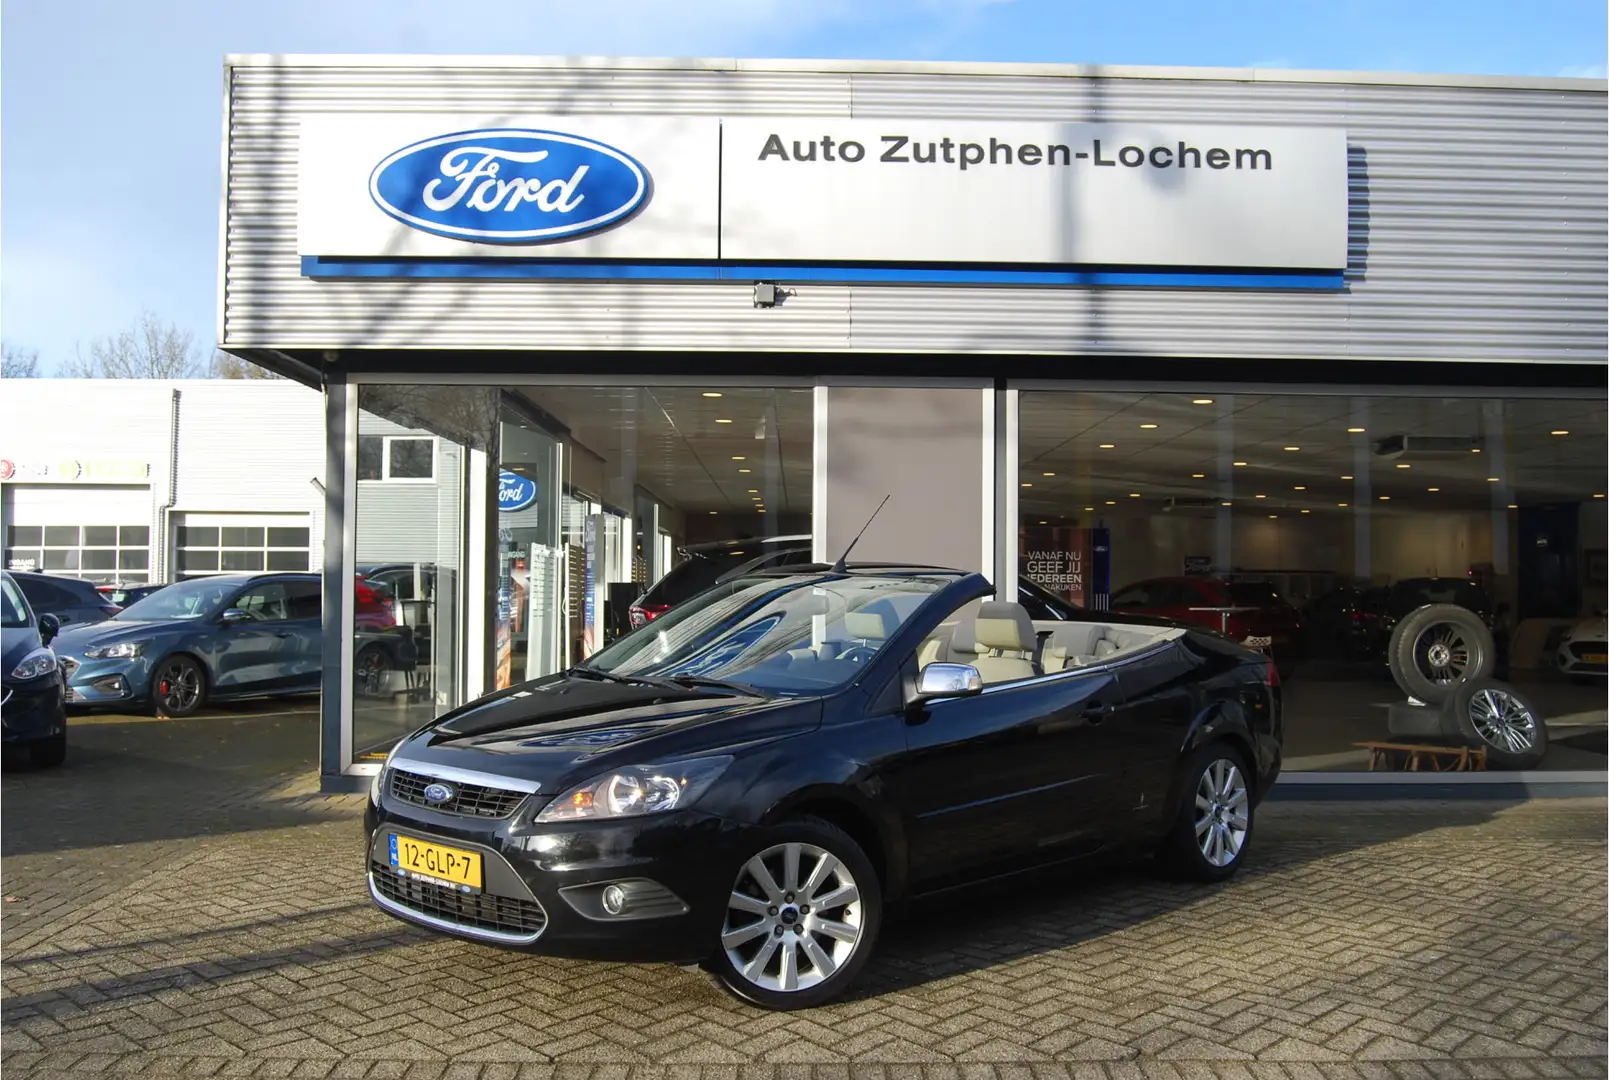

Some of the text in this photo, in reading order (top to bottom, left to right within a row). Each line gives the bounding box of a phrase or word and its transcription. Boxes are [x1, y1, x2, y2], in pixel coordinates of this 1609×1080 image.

[757, 132, 1273, 171] Auto Zutphen-Lochem
[422, 146, 590, 213] Ford
[1027, 551, 1082, 560] VANAF NU
[1027, 561, 1081, 573] GEEF JIJ
[1027, 574, 1082, 583] EDEREEN
[404, 843, 471, 880] 12-GLP-7
